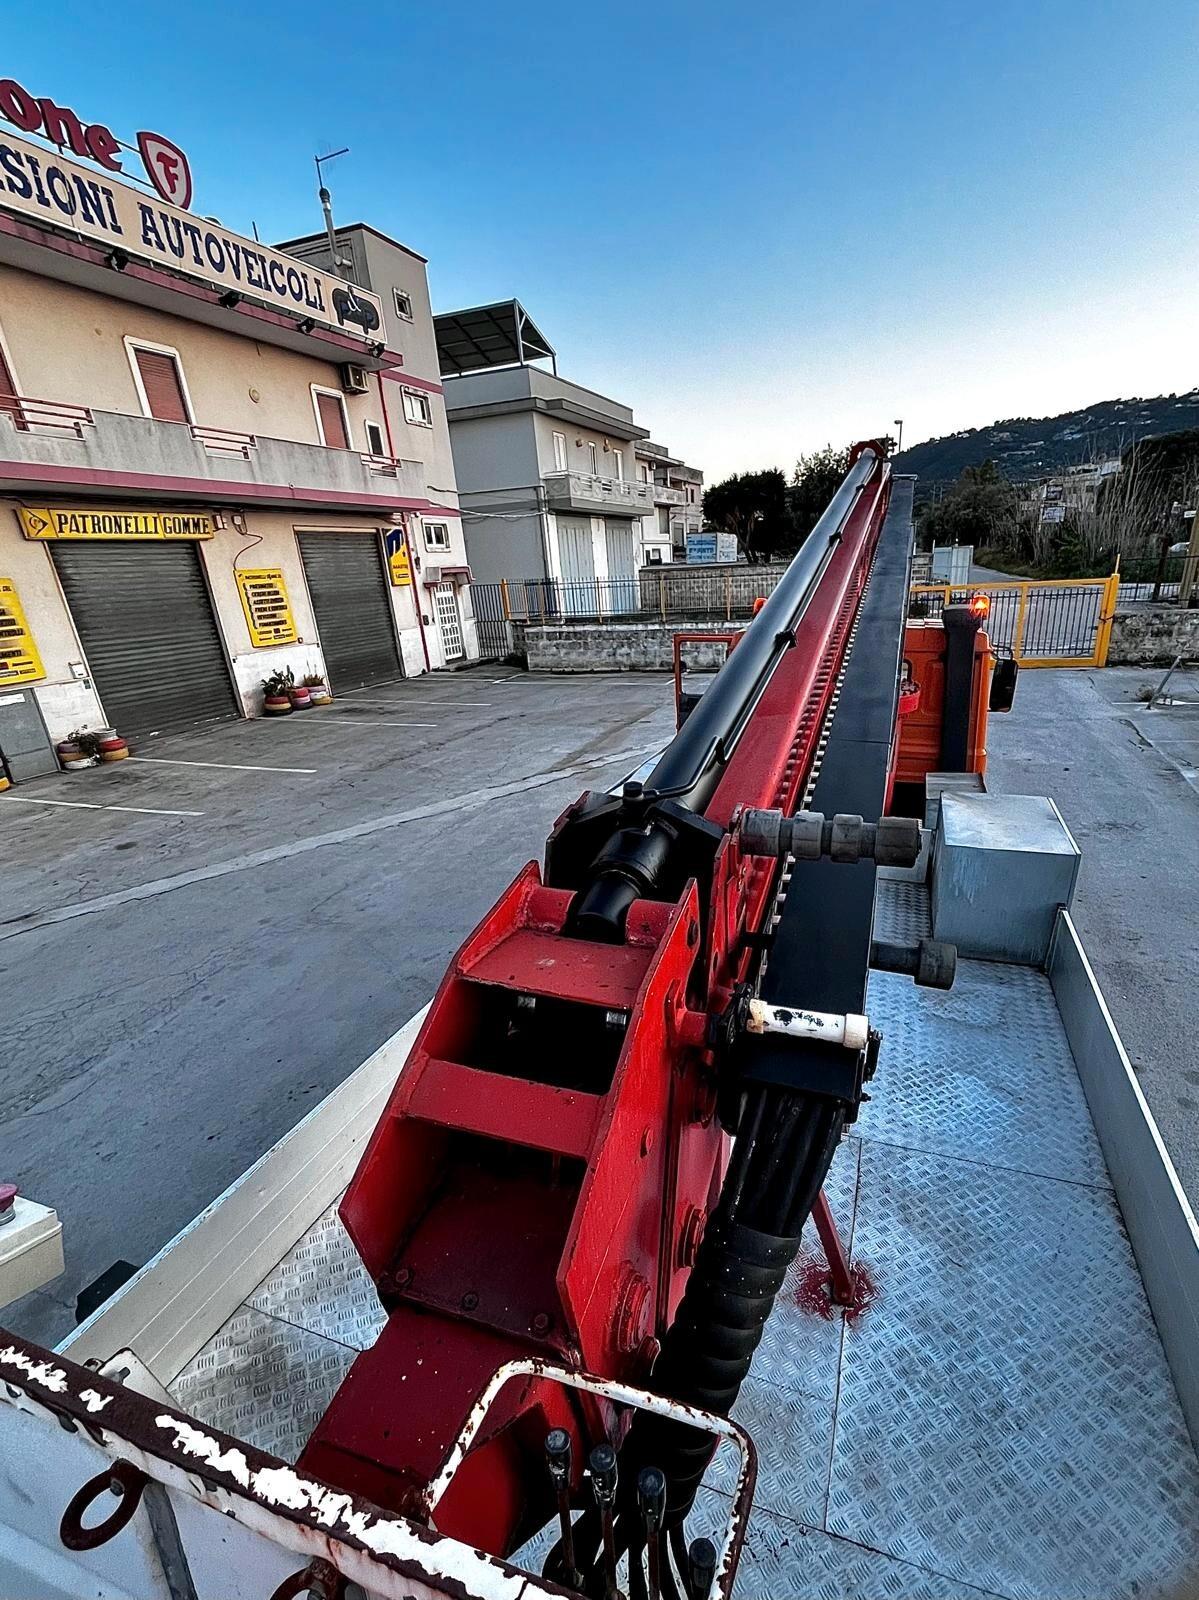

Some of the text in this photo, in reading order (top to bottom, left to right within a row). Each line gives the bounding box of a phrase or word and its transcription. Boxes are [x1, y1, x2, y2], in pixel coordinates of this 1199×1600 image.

[0, 79, 122, 171] one
[156, 150, 179, 194] F
[0, 144, 325, 312] SIONI AUTOVEICOLI
[56, 513, 211, 535] PATRONELLI GOMME
